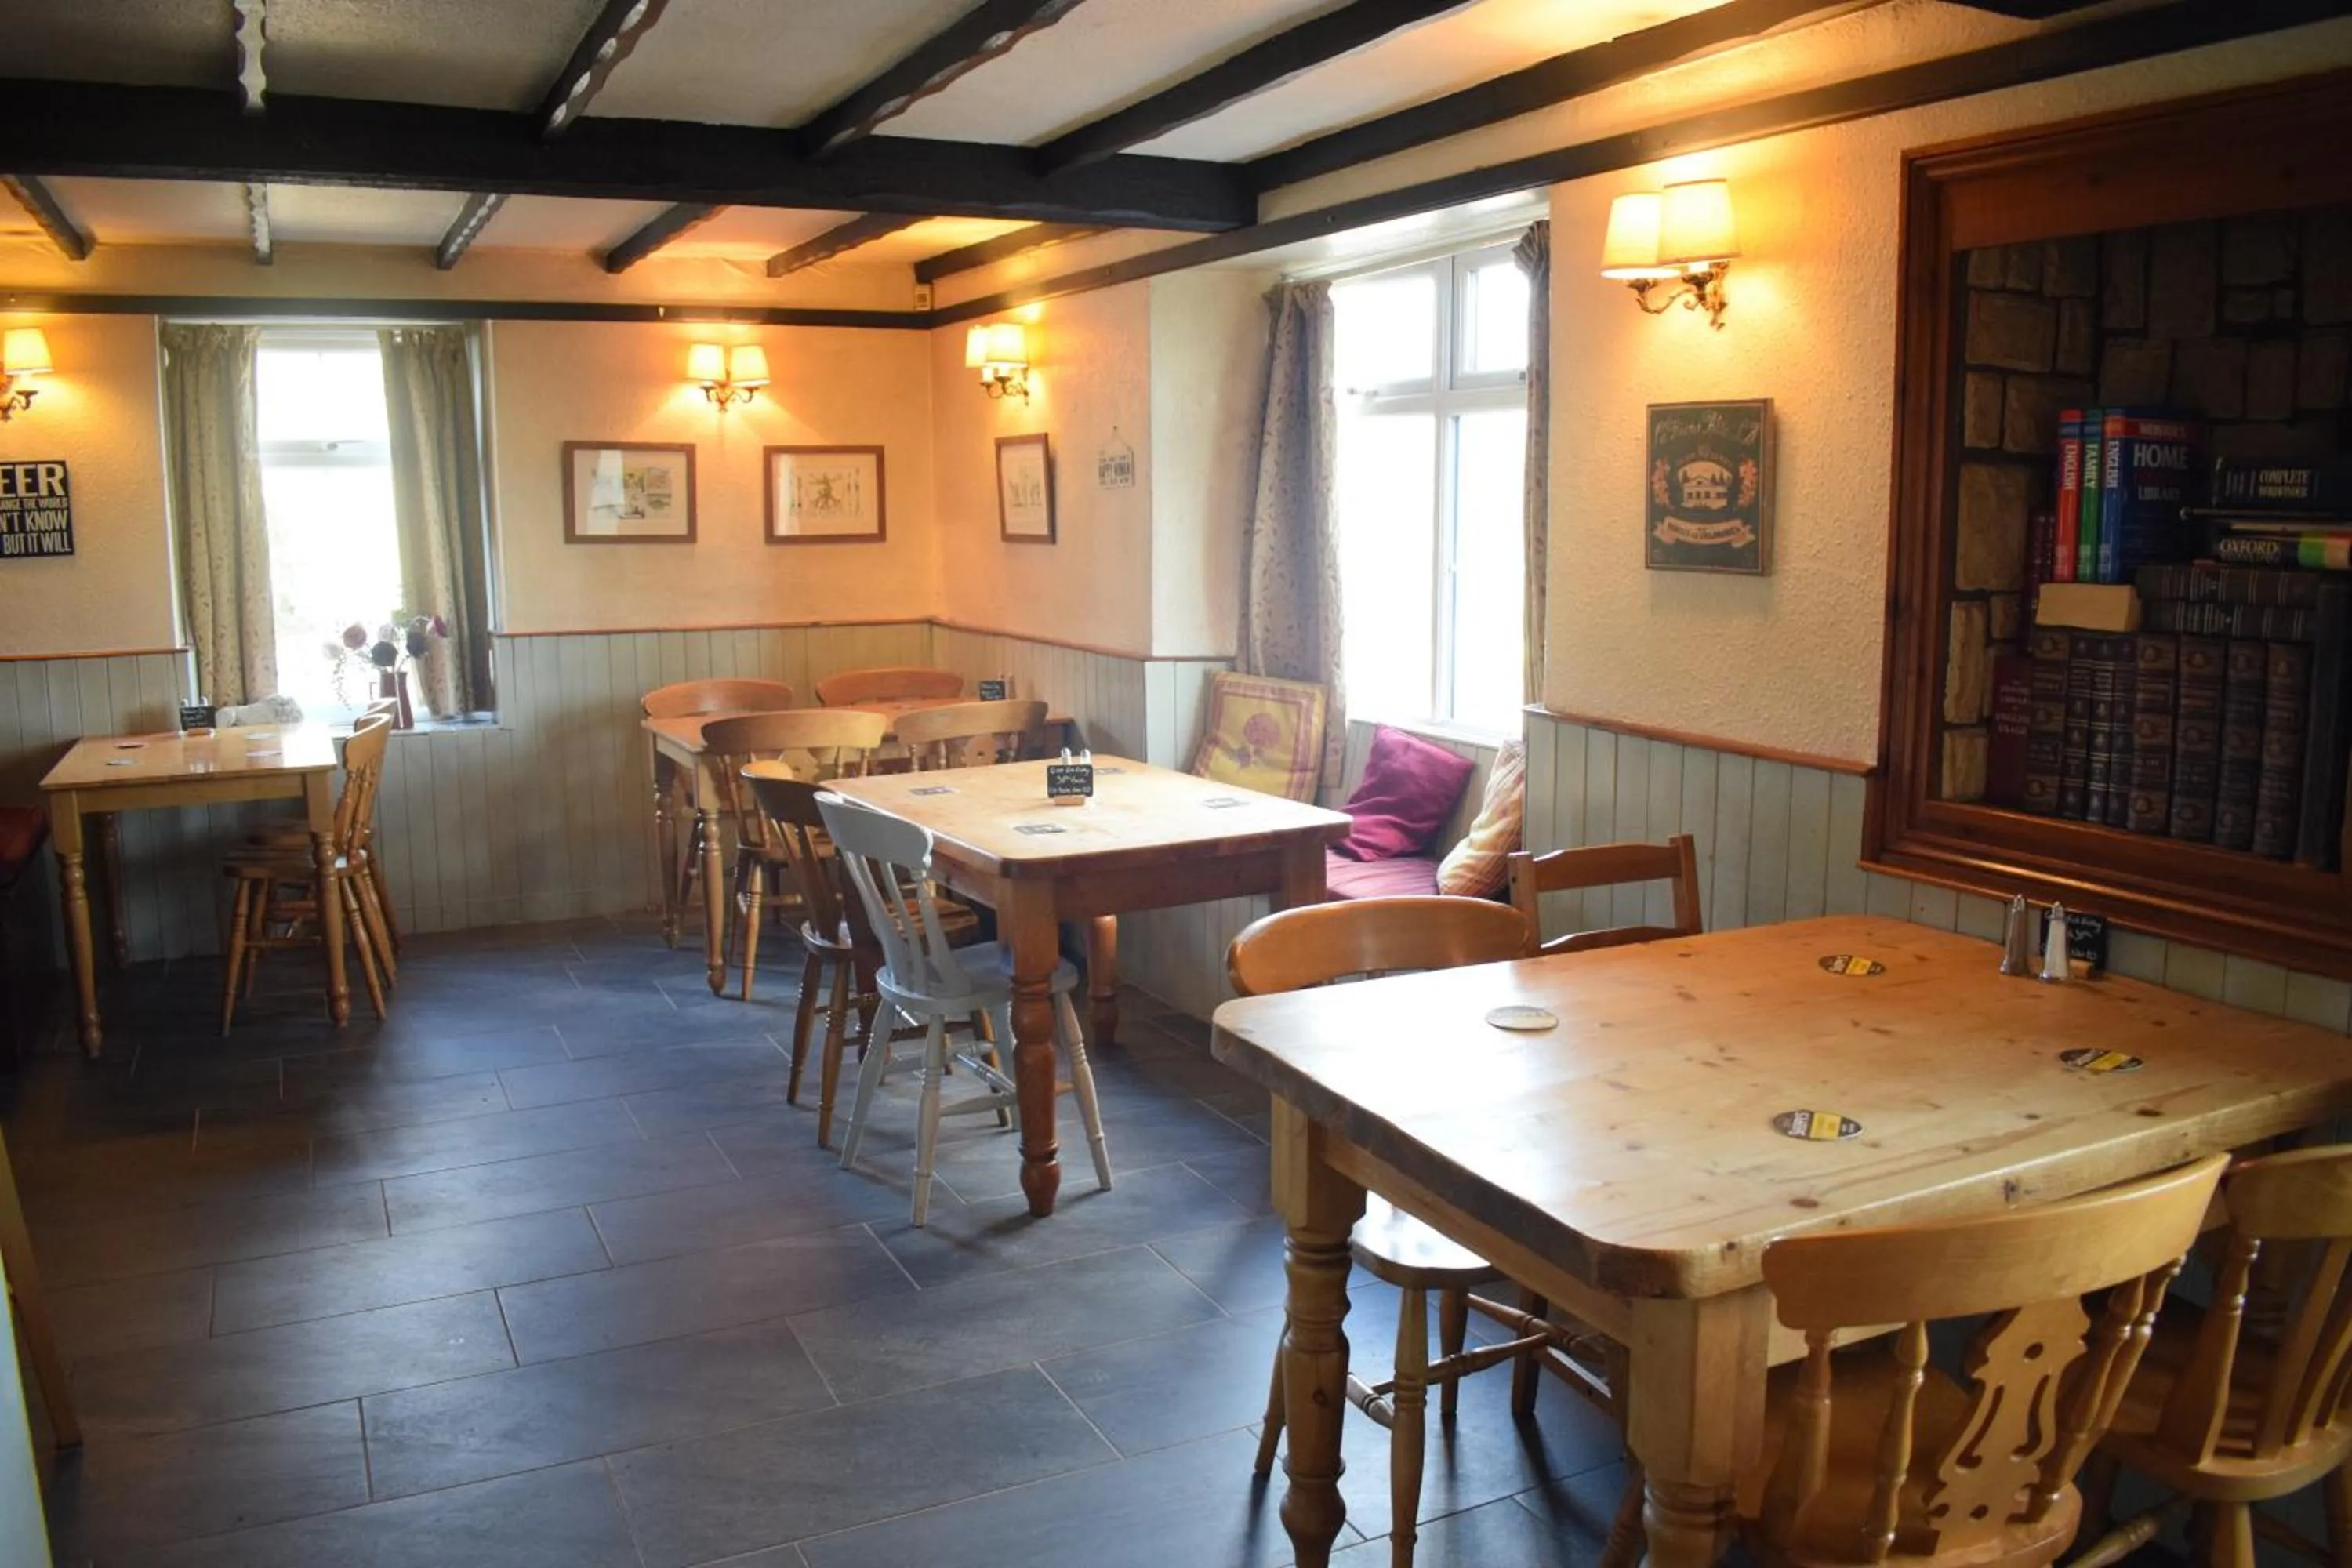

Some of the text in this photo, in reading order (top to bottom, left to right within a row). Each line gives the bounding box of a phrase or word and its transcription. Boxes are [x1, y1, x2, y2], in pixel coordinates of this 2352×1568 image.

[2084, 443, 2098, 488] FAMILY
[2106, 440, 2120, 488] ENGLISH
[2132, 443, 2190, 470] HOME
[2259, 468, 2310, 484] COMPLETE
[24, 510, 68, 531] KNOW
[2, 532, 72, 554] BUT IT WILL
[2220, 539, 2279, 554] OXFORD
